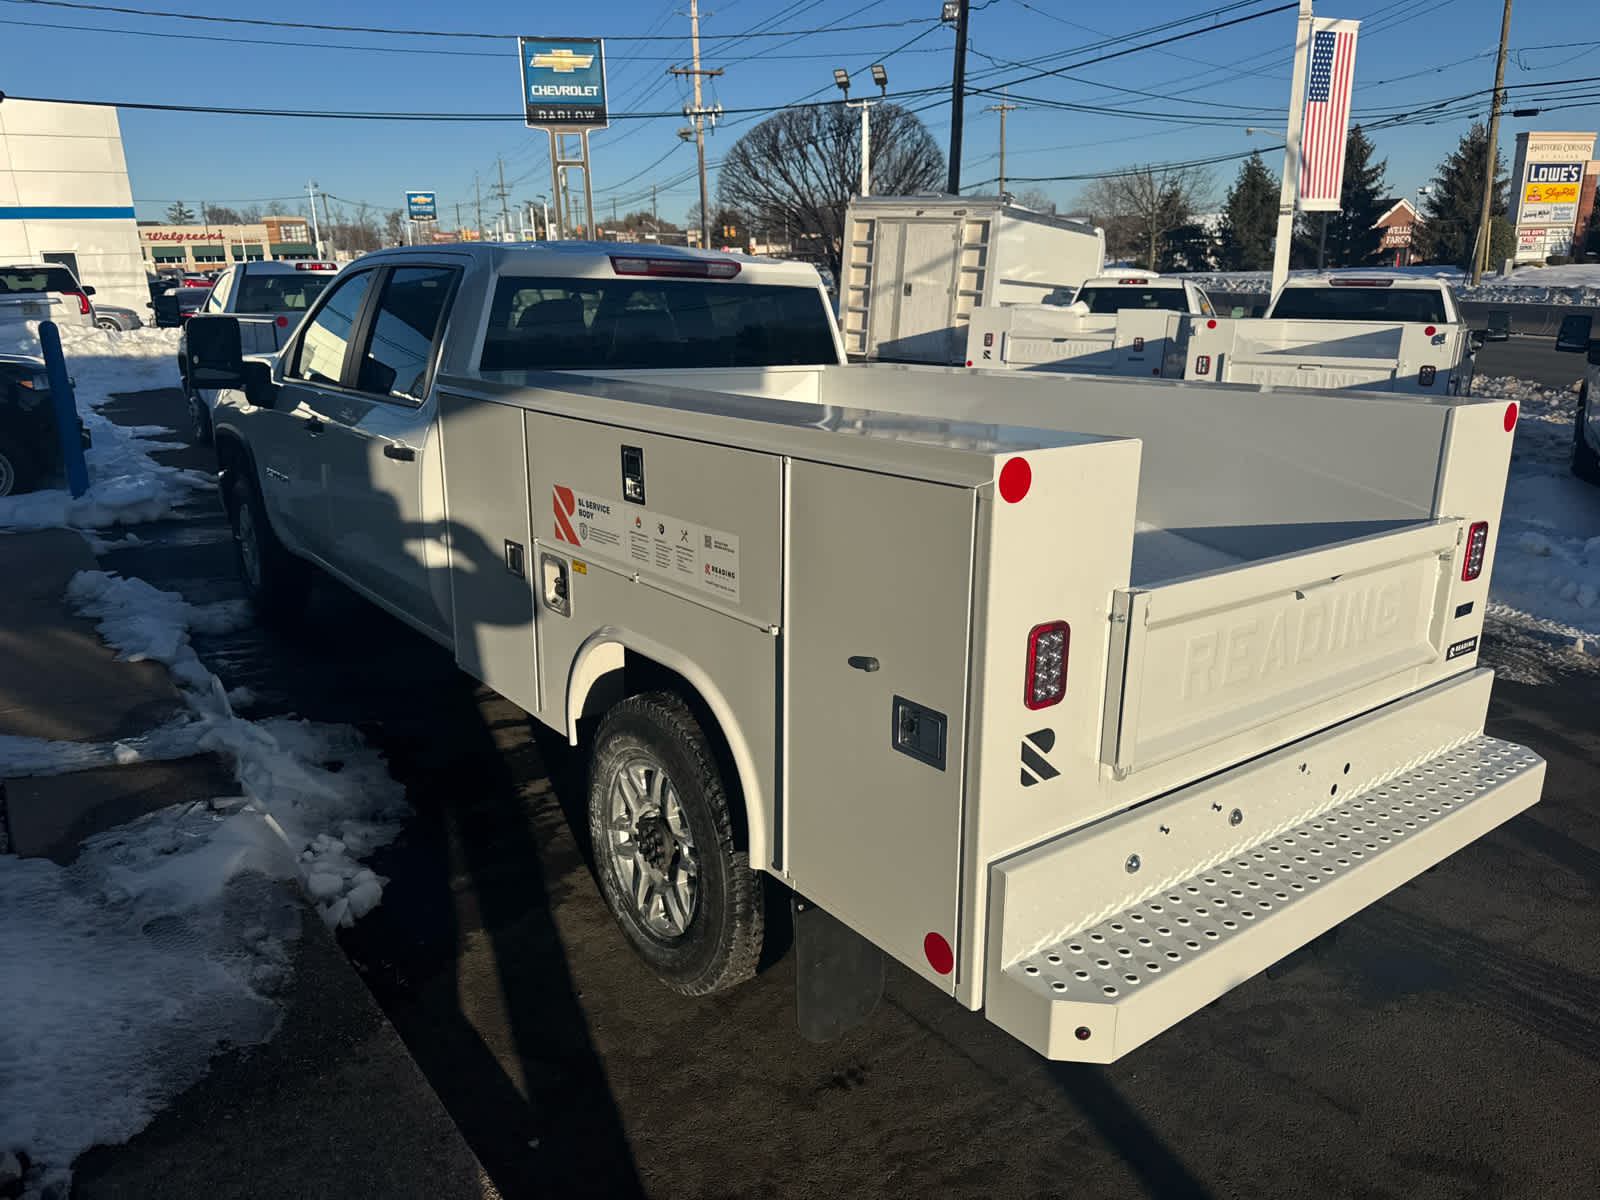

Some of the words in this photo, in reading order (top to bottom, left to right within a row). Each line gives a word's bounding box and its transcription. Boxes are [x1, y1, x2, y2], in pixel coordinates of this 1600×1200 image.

[531, 85, 599, 96] CHEVROLET
[1530, 165, 1579, 182] LOWE'S
[145, 232, 225, 243] Walgreens
[578, 498, 585, 507] SL
[586, 500, 610, 515] SERVICE
[578, 508, 593, 519] BODY
[711, 565, 736, 579] READING
[1180, 584, 1402, 700] READING
